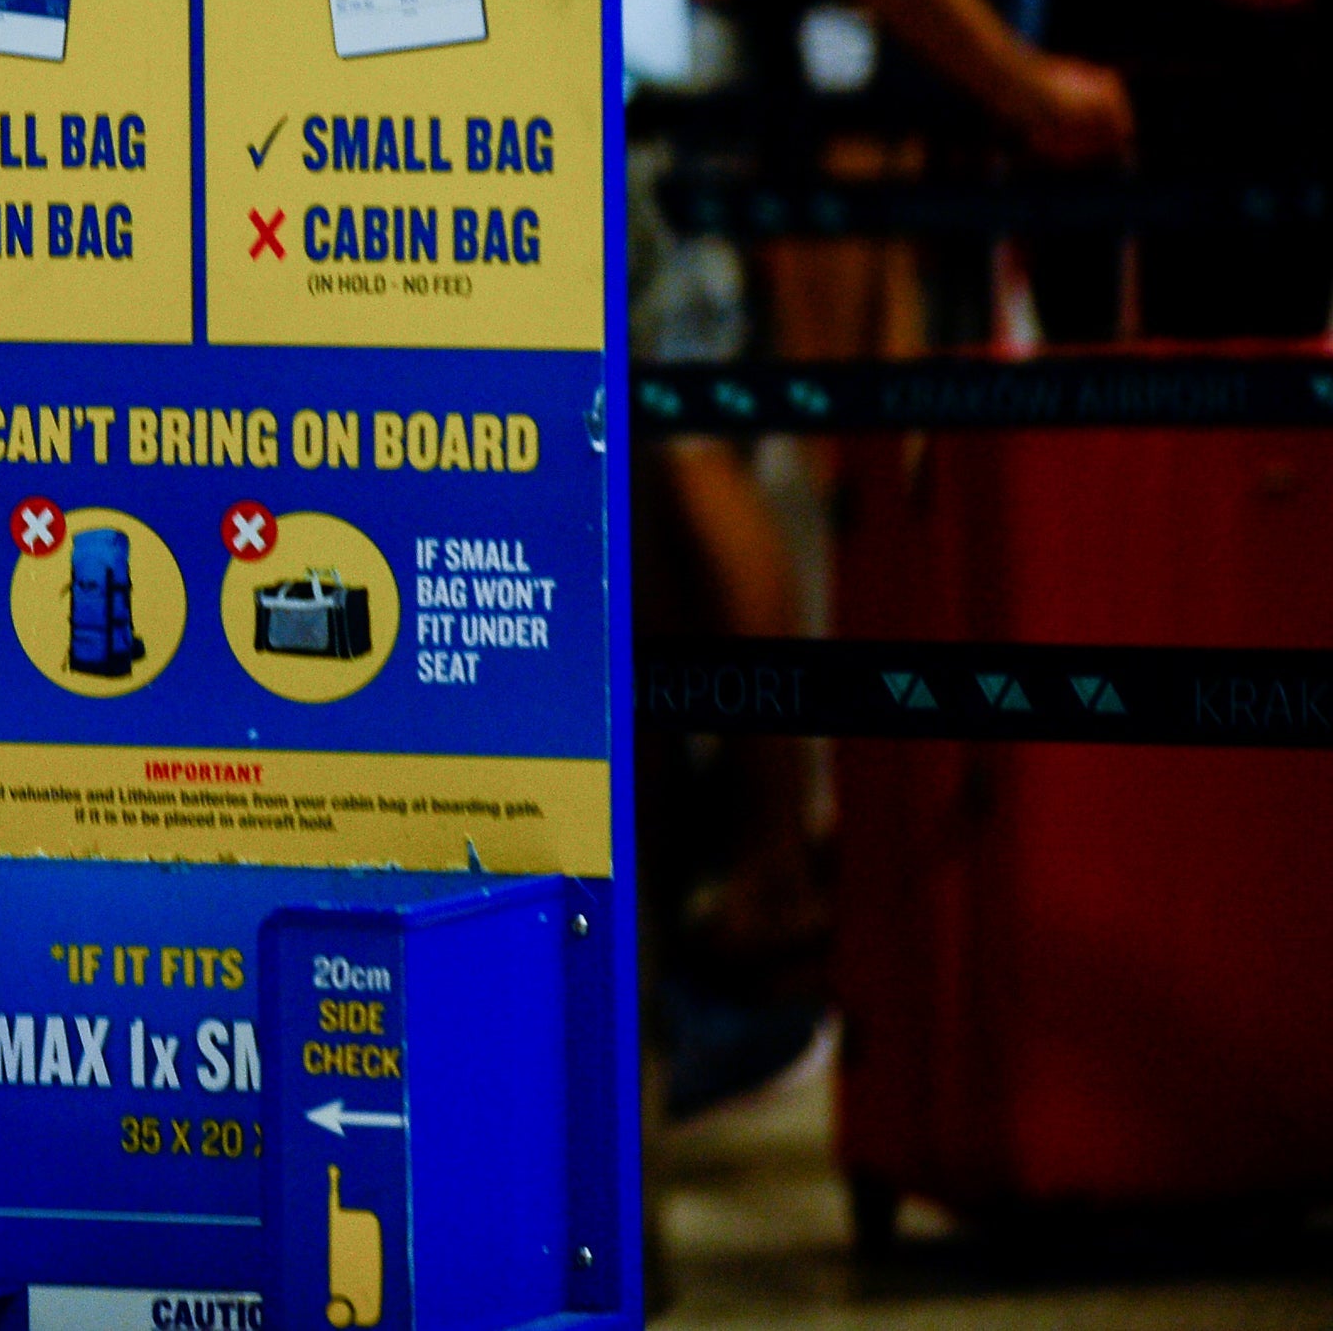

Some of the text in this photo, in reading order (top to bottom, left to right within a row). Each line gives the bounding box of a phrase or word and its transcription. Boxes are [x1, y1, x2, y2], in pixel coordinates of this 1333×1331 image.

[61, 114, 145, 170] BAG
[303, 115, 553, 174] SMALL BAG
[48, 203, 132, 259] BAG
[304, 205, 539, 264] CABIN BAG
[308, 275, 332, 296] (IN
[338, 274, 386, 295] HOLD
[403, 275, 426, 295] NO
[433, 276, 472, 295] FEE)
[129, 408, 277, 467] BRING
[293, 410, 359, 468] ON
[374, 412, 538, 471] BOARD
[417, 539, 529, 572] IF SMALL
[417, 576, 555, 610] BAG WON'T
[418, 614, 548, 647] FIT UNDER
[418, 651, 479, 682] SEAT
[145, 762, 261, 783] IMPORTANT
[114, 946, 150, 985] IT
[161, 947, 244, 989] FITS
[313, 956, 390, 990] 20cm
[320, 999, 384, 1034] SIDE
[303, 1042, 400, 1078] CHECK
[122, 1116, 162, 1154] 35
[172, 1120, 191, 1153] X
[201, 1120, 243, 1157] 20
